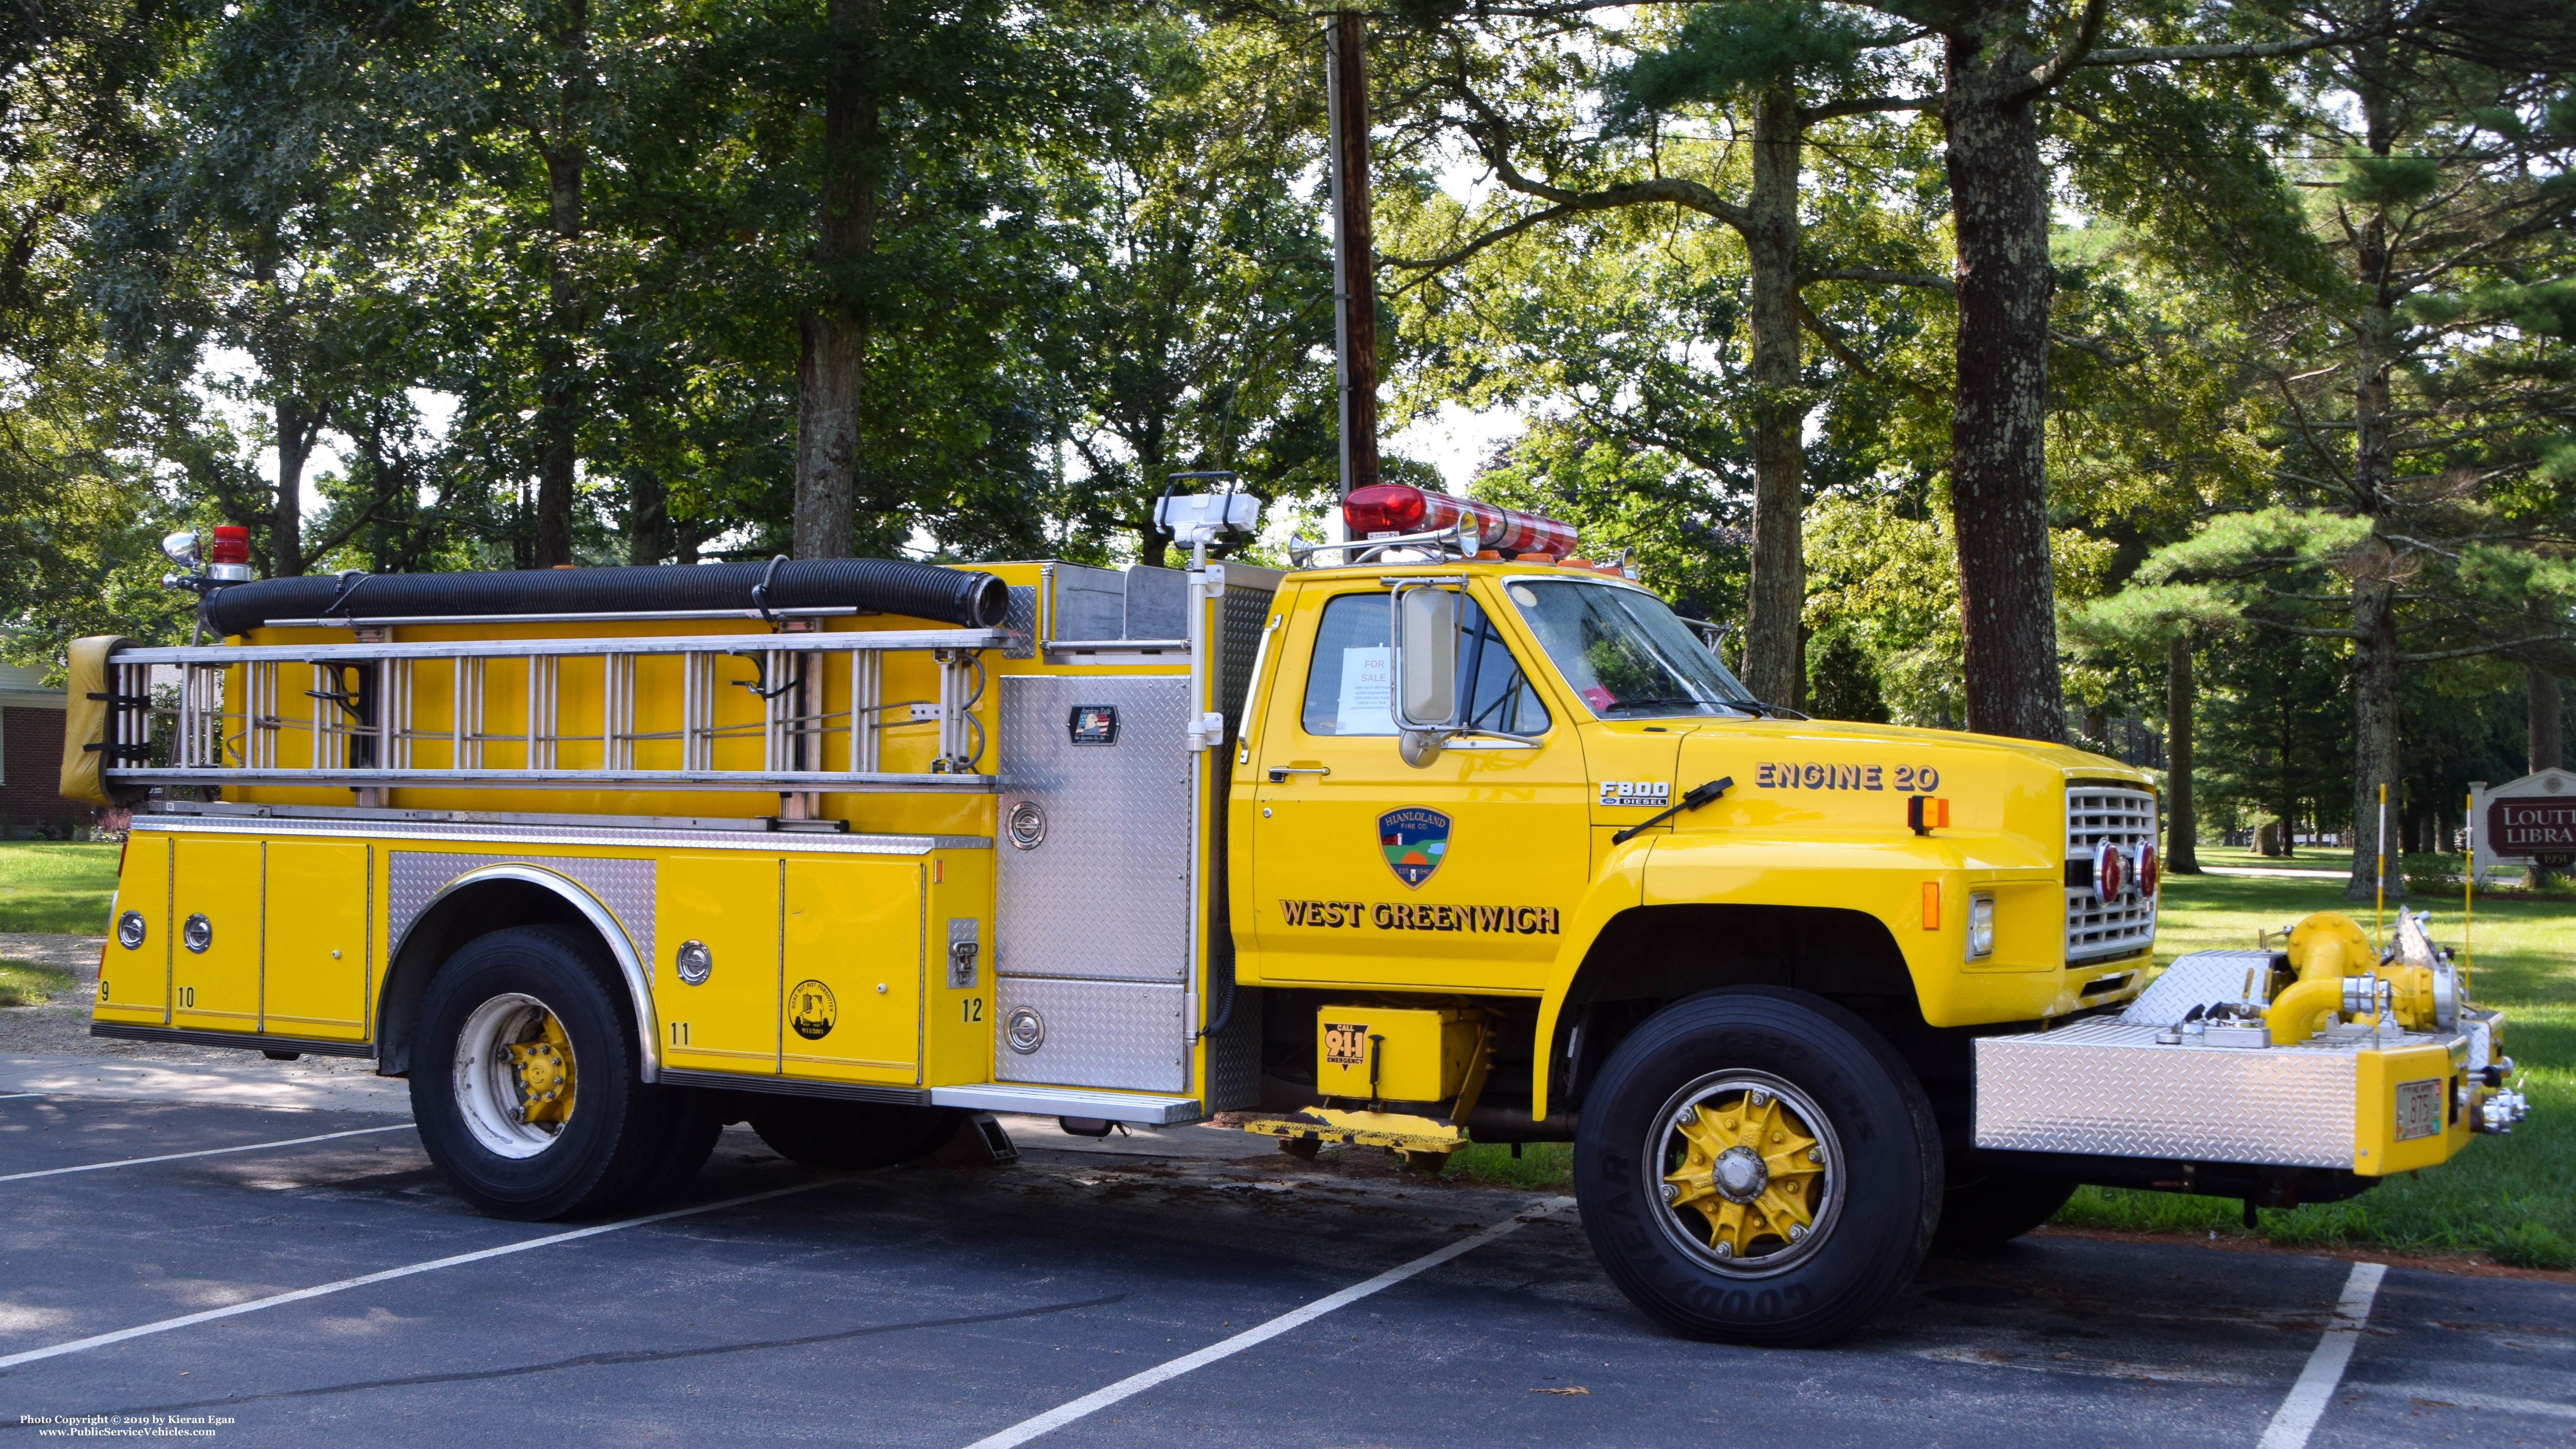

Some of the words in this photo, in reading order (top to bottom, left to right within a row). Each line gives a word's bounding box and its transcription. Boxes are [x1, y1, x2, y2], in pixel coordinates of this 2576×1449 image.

[1600, 781, 1669, 797] F800
[1755, 762, 1883, 790] ENGINE
[1892, 764, 1940, 792] 20
[1386, 812, 1446, 828] HIANLOLAND
[2507, 828, 2576, 843] LIBRA
[1278, 899, 1365, 928] WEST
[1370, 902, 1560, 934] GREENWICH
[101, 980, 109, 1001] 9
[178, 986, 194, 1008] 10
[797, 984, 806, 994] BUT
[817, 984, 834, 1012] FORGOTTEN
[963, 998, 983, 1022] 12
[671, 1022, 689, 1046] 11
[2410, 1094, 2429, 1124] 875
[1602, 1153, 1813, 1321] GOODYEAR
